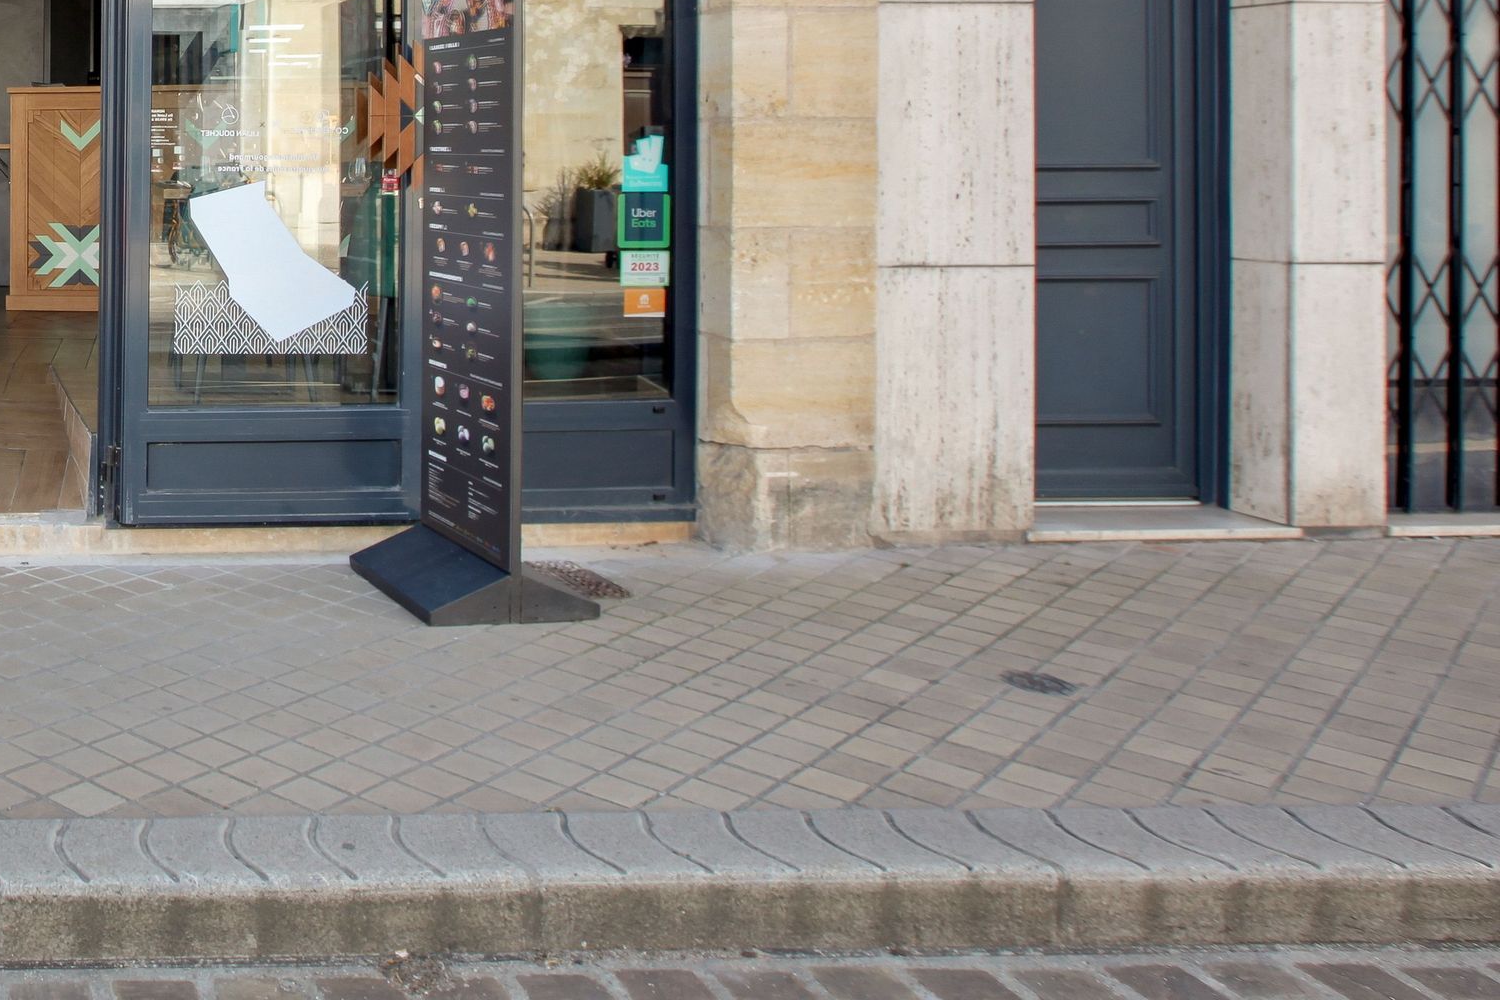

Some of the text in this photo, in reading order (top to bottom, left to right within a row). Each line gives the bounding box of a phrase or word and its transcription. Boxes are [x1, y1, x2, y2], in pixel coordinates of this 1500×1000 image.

[631, 208, 657, 218] Uber
[631, 219, 656, 228] Eats
[631, 262, 660, 272] 2023
